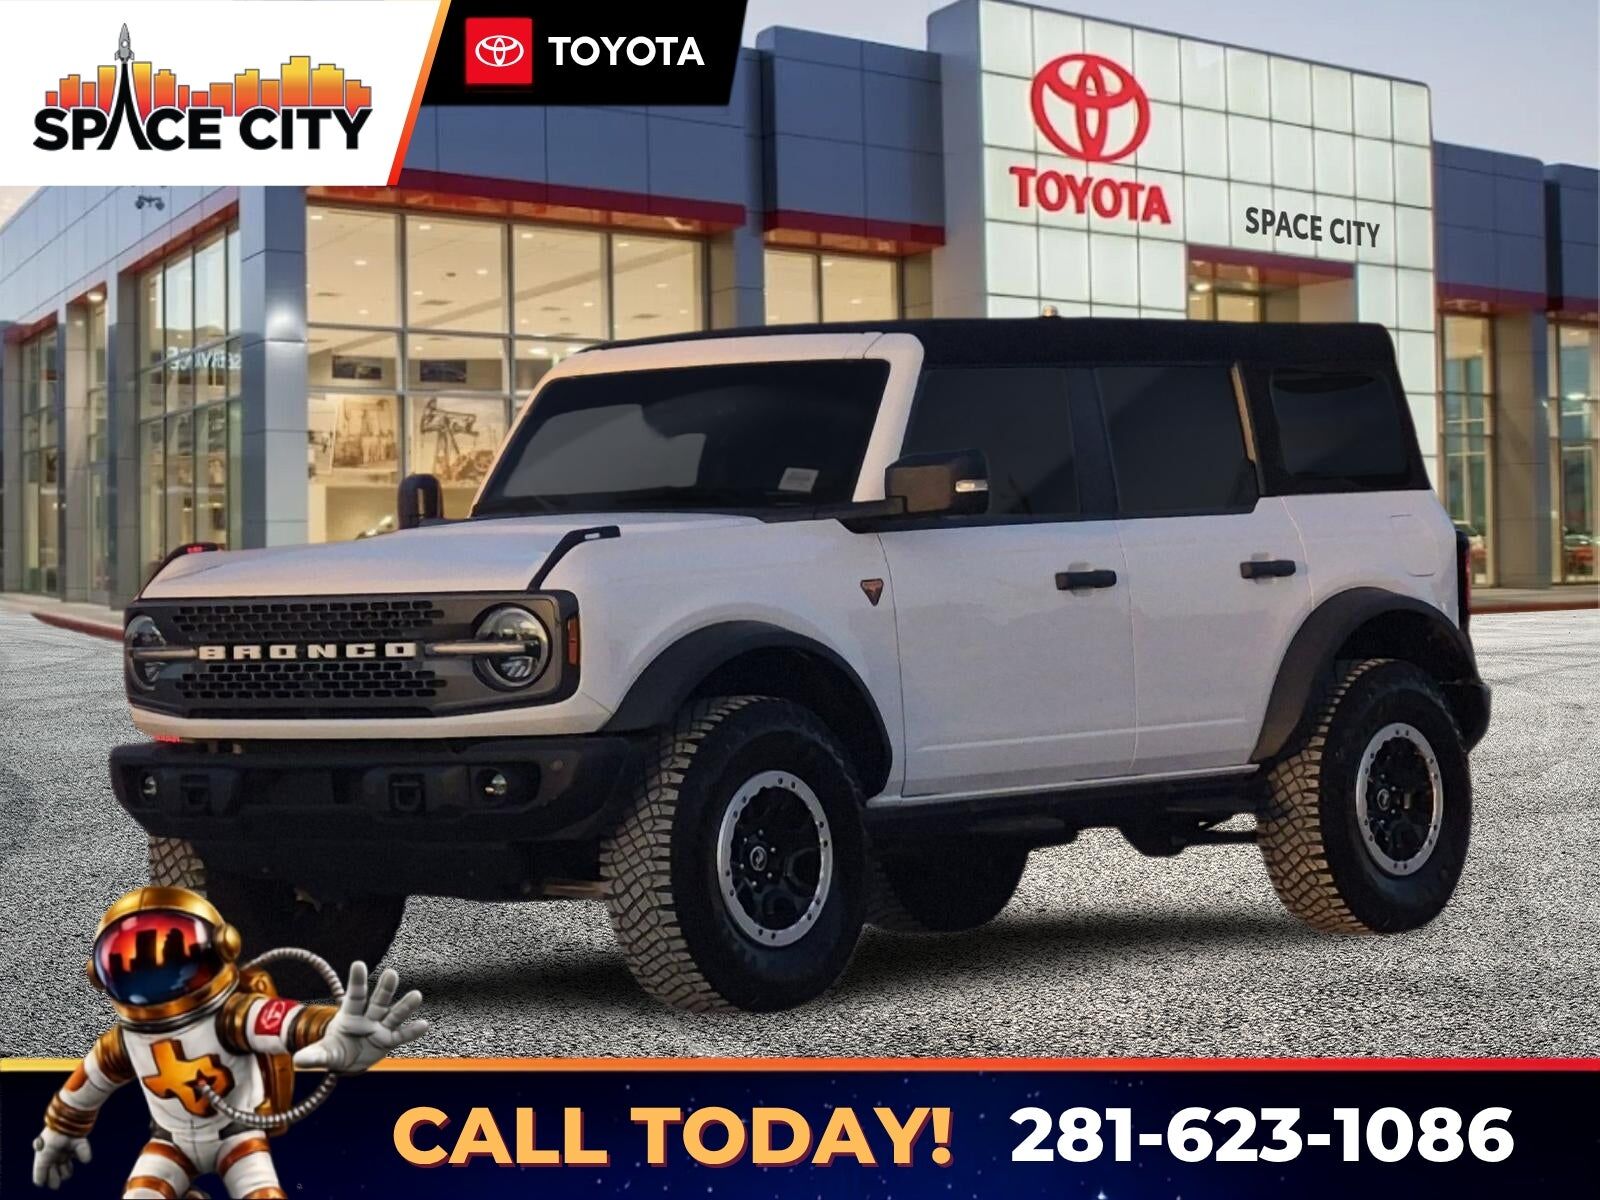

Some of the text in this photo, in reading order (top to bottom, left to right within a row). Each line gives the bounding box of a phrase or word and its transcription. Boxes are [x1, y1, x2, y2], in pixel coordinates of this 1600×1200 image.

[1009, 166, 1171, 225] TOYOTA
[1245, 206, 1381, 248] SPACE CITY
[199, 642, 417, 661] BRONCO
